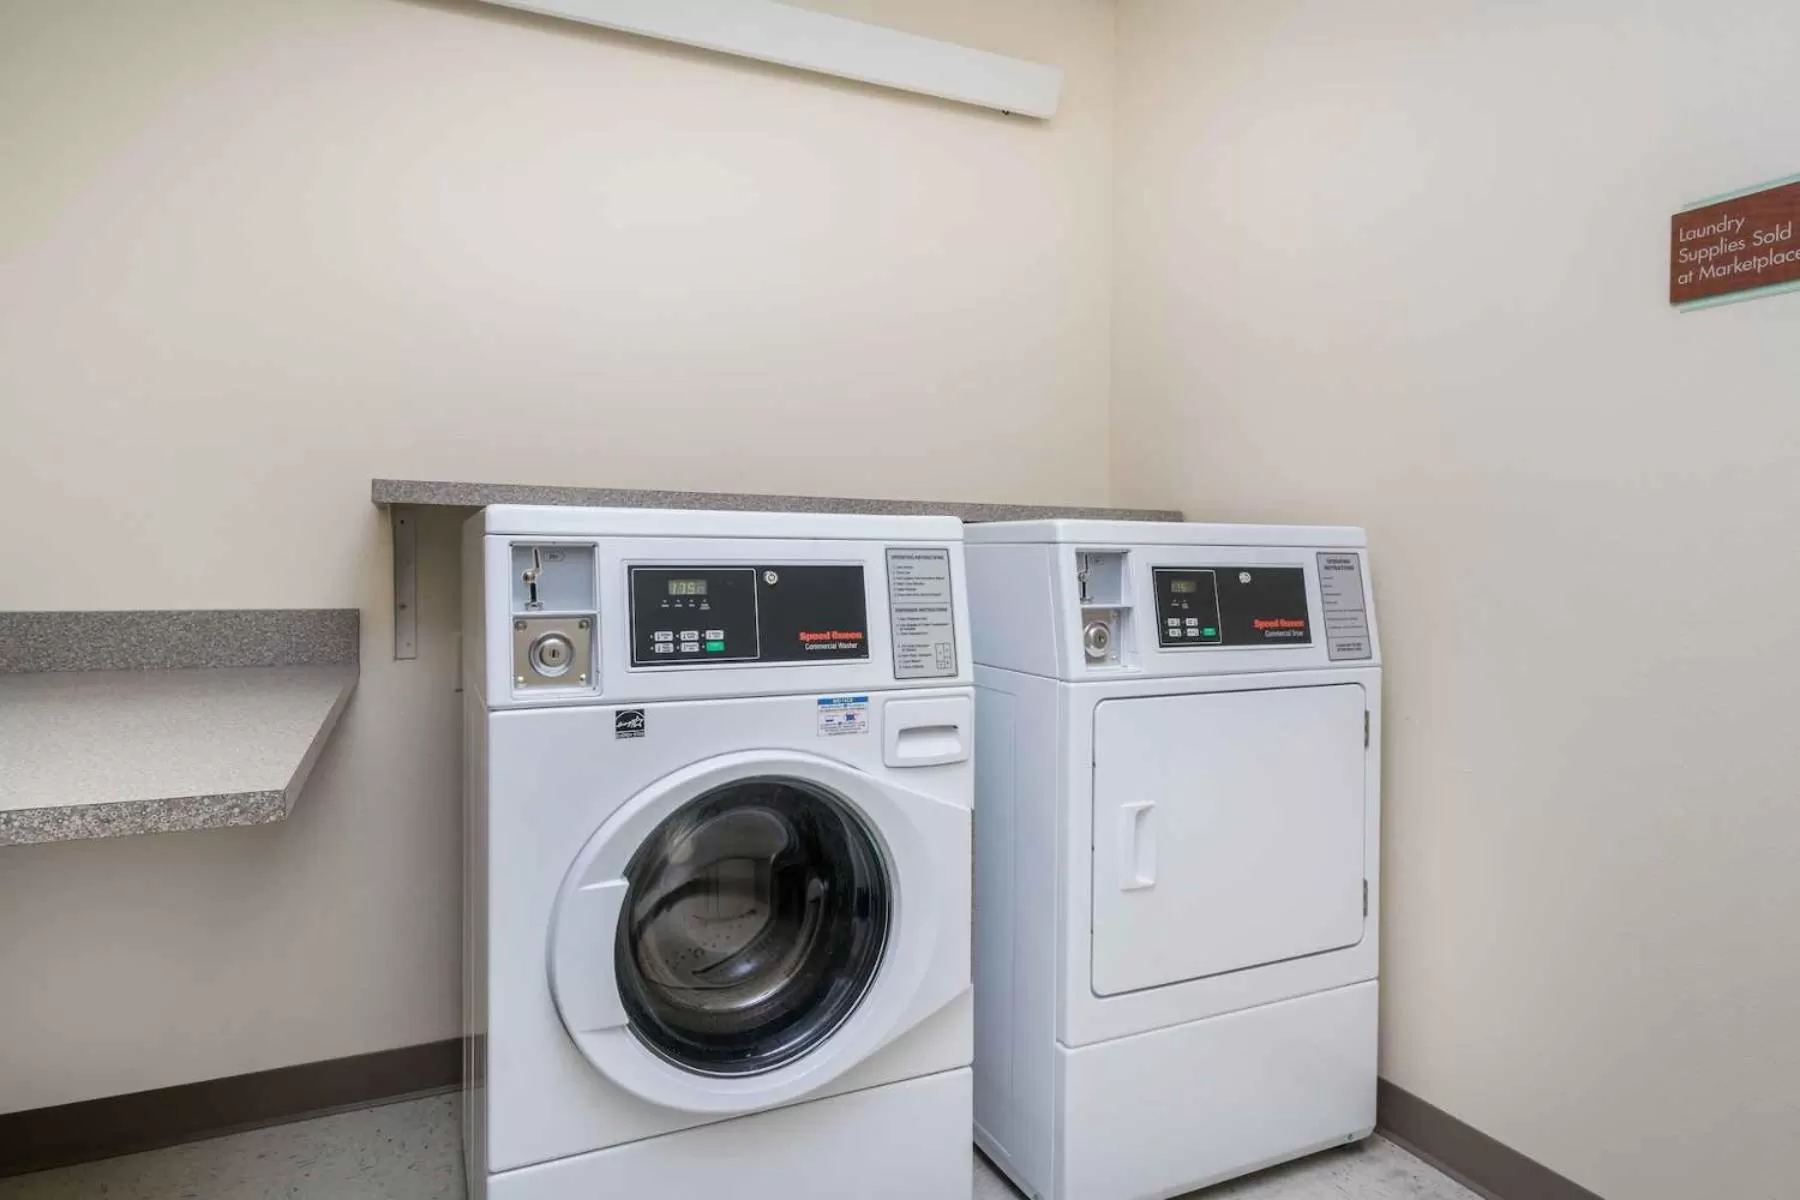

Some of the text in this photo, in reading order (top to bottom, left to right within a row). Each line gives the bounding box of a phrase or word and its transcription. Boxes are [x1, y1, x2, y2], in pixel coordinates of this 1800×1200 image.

[1679, 214, 1745, 242] Laundry
[1679, 221, 1792, 264] Supplies Sold
[1678, 270, 1693, 285] at
[799, 631, 831, 642] Speed
[804, 642, 837, 650] Commercial
